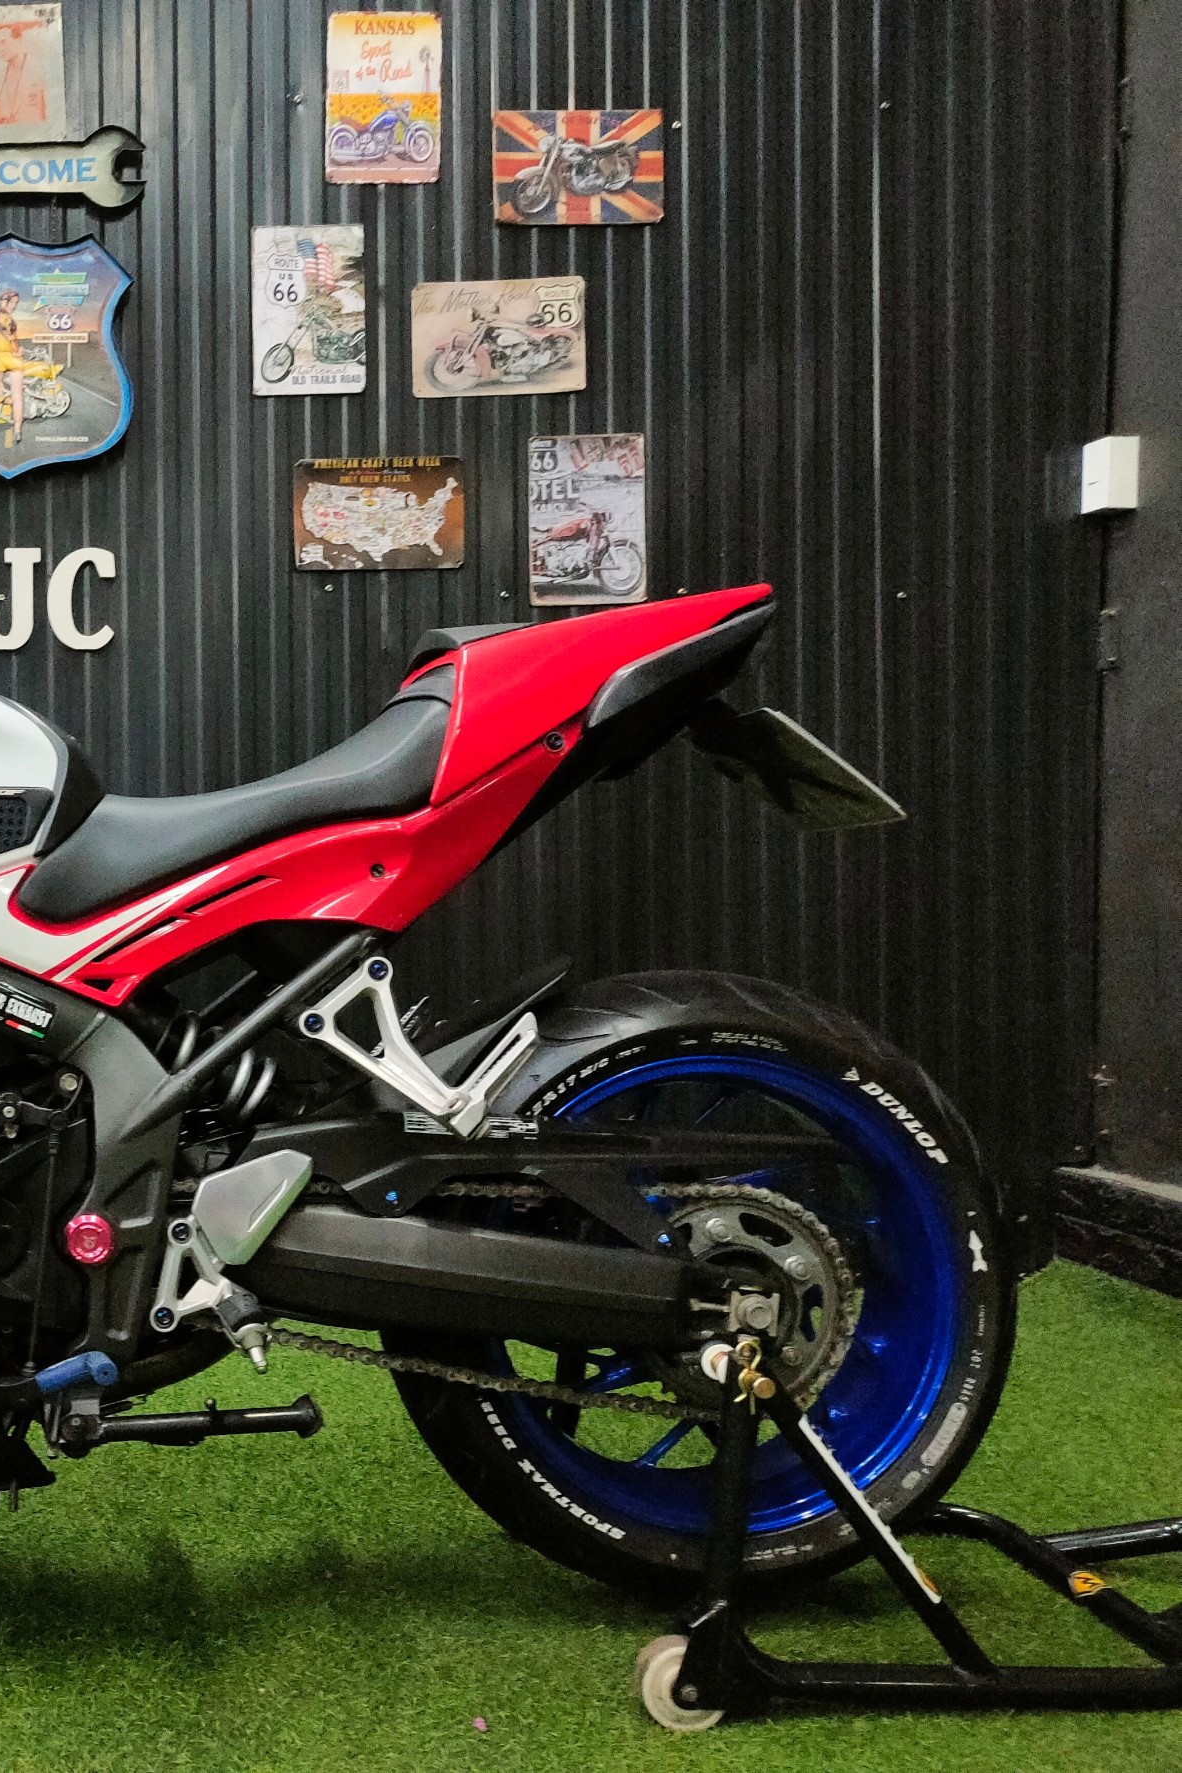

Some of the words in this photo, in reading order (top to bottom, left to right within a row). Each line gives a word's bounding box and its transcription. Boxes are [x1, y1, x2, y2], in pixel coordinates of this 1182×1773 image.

[354, 20, 416, 35] KANSAS
[379, 58, 414, 83] Road
[274, 257, 300, 269] ROUTE
[278, 273, 293, 281] US
[273, 283, 298, 302] 66
[497, 281, 536, 303] Road
[544, 289, 572, 298] ROUTE
[49, 314, 73, 330] 66
[541, 302, 573, 324] 66
[531, 451, 554, 471] 66
[858, 1081, 949, 1164] DUNLOP
[518, 1458, 626, 1540] SPORTMAX
